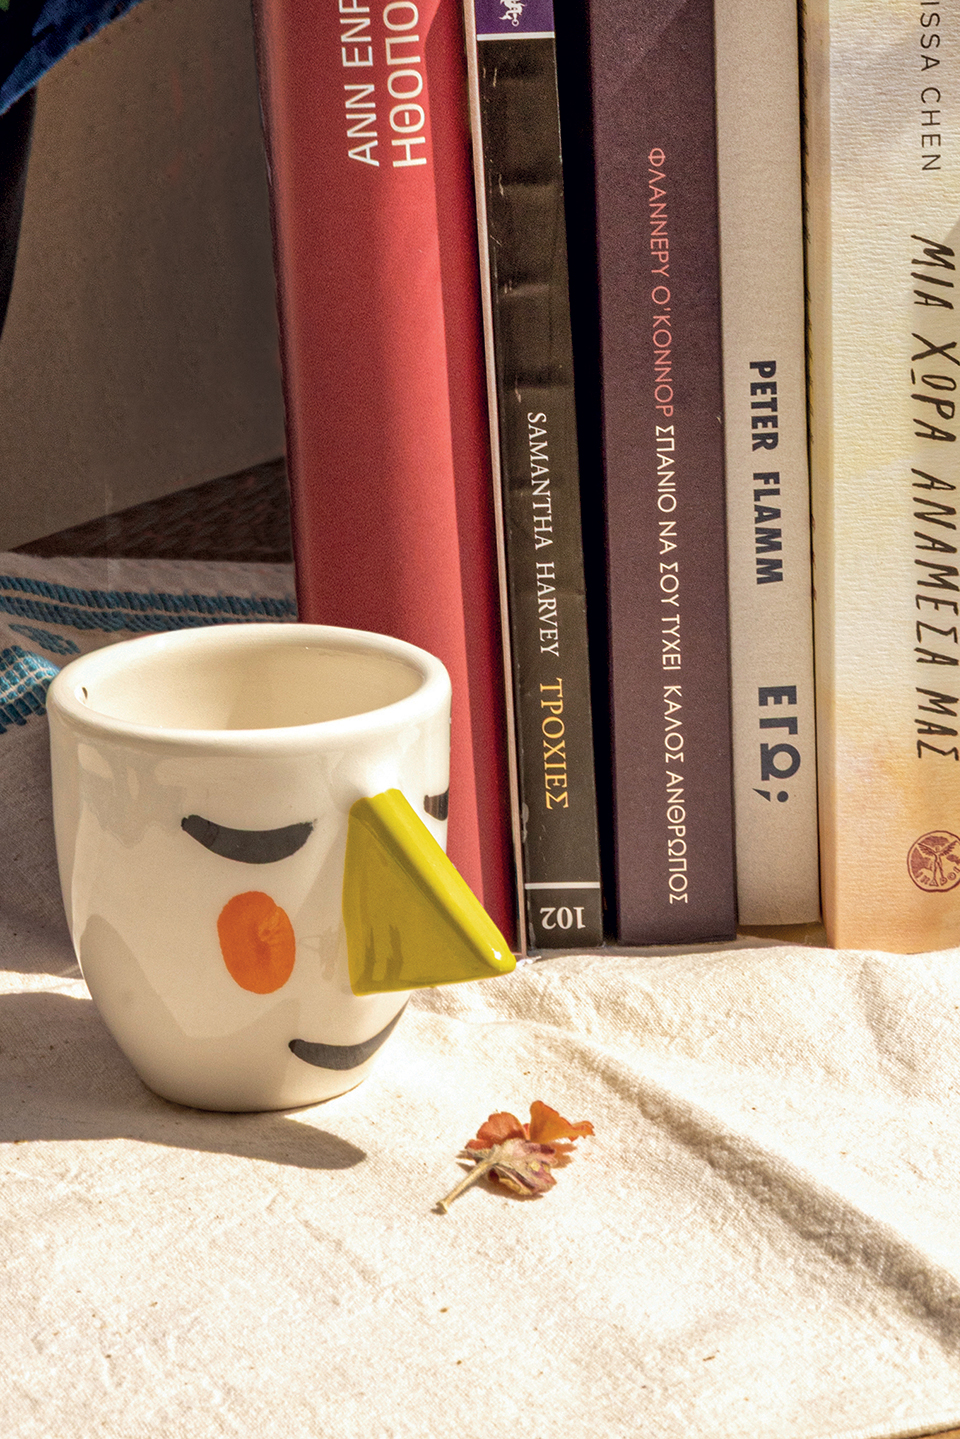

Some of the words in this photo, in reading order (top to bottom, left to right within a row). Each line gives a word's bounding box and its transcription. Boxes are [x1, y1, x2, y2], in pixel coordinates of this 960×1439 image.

[344, 76, 380, 167] ΑΝΝ
[920, 86, 941, 172] CHEN
[648, 148, 669, 278] ΦΛΑΝΝΕΡΥ
[911, 234, 956, 310] ΜΙΑ
[749, 360, 779, 451] PETER
[527, 412, 552, 551] SAMANTHA
[655, 425, 677, 514] ΣΠΑΝΙΟ
[659, 520, 677, 555] ΝΑ
[753, 471, 783, 585] FLAMM
[911, 467, 960, 667] ΑΝΑΜΕΣΑ
[535, 562, 560, 658] HARVEY
[660, 562, 680, 607] ΣΟΥ
[661, 612, 681, 670] ΤΥΧΕΙ
[540, 677, 569, 810] ΤΡΟΧΙΕΣ
[663, 684, 684, 764] ΚΑΛΟΣ
[753, 685, 801, 803] ΕΓΩ;
[916, 687, 959, 762] ΜΑΣ
[666, 771, 688, 903] ΑΝΘΡΩΠΟΣ
[539, 905, 586, 930] 102
